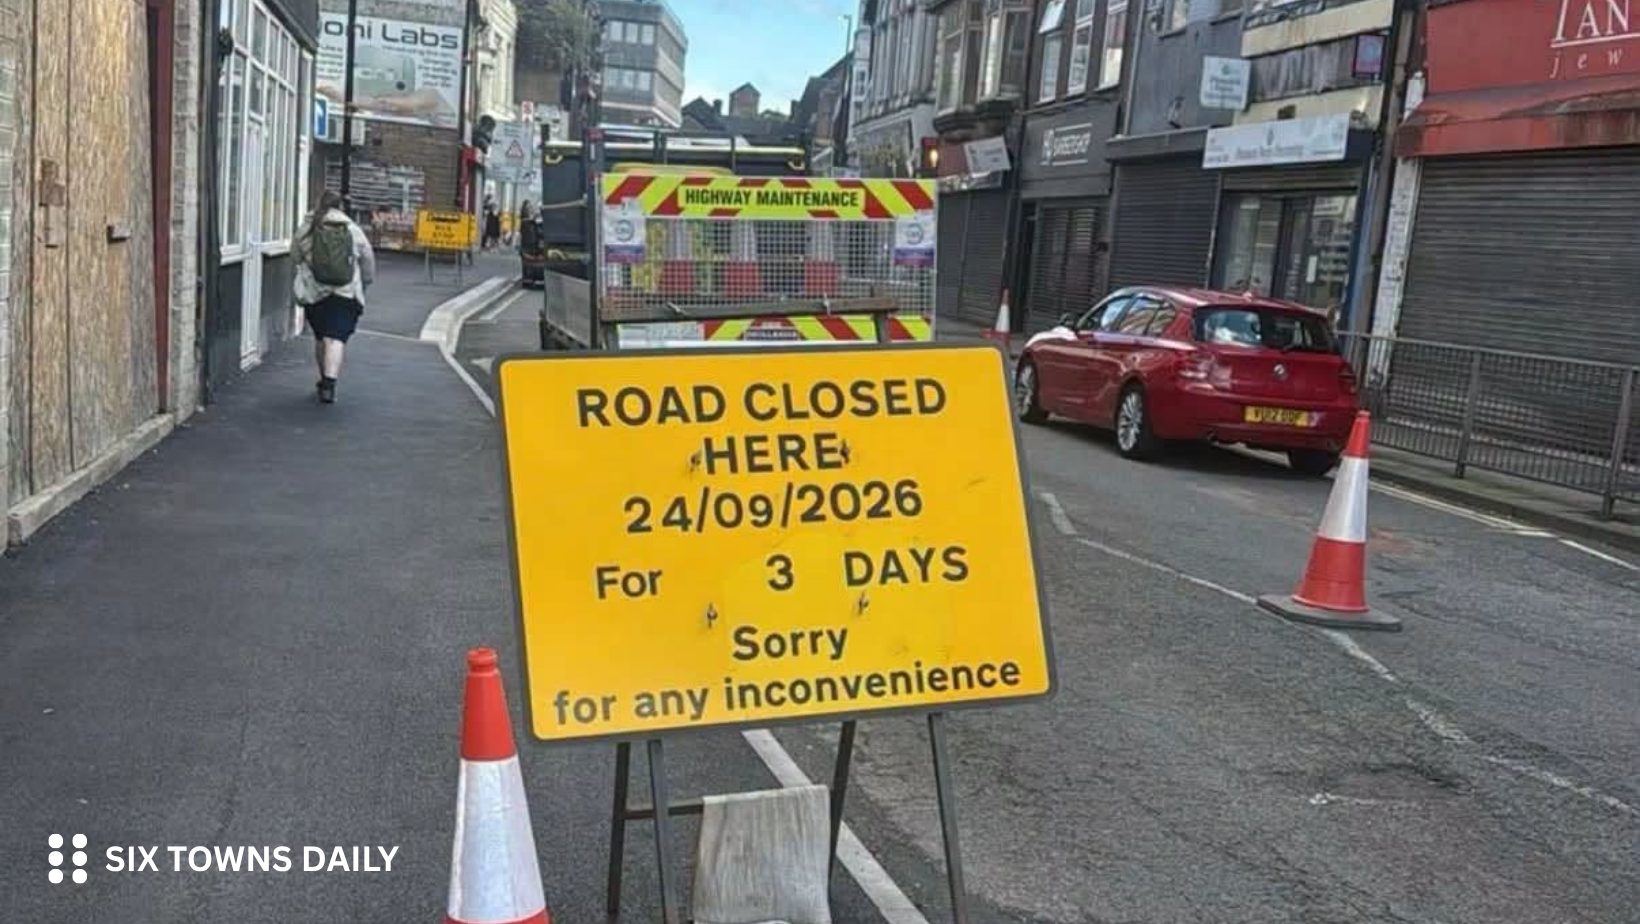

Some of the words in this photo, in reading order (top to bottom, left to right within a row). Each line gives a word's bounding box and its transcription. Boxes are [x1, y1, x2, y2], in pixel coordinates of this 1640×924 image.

[318, 19, 372, 39] oni
[382, 23, 458, 49] Labs
[685, 188, 751, 205] HIGHWAY
[756, 190, 859, 207] MAINTENANCE
[578, 386, 725, 427] ROAD
[744, 379, 945, 421] CLOSED
[705, 433, 842, 474] HERE
[625, 480, 921, 533] 24/09/2026
[596, 566, 662, 599] For
[767, 555, 794, 591] 3
[845, 547, 968, 587] DAYS
[733, 627, 847, 660] Sorry
[554, 692, 616, 724] for
[636, 688, 708, 719] any
[726, 662, 1020, 709] inconvenience
